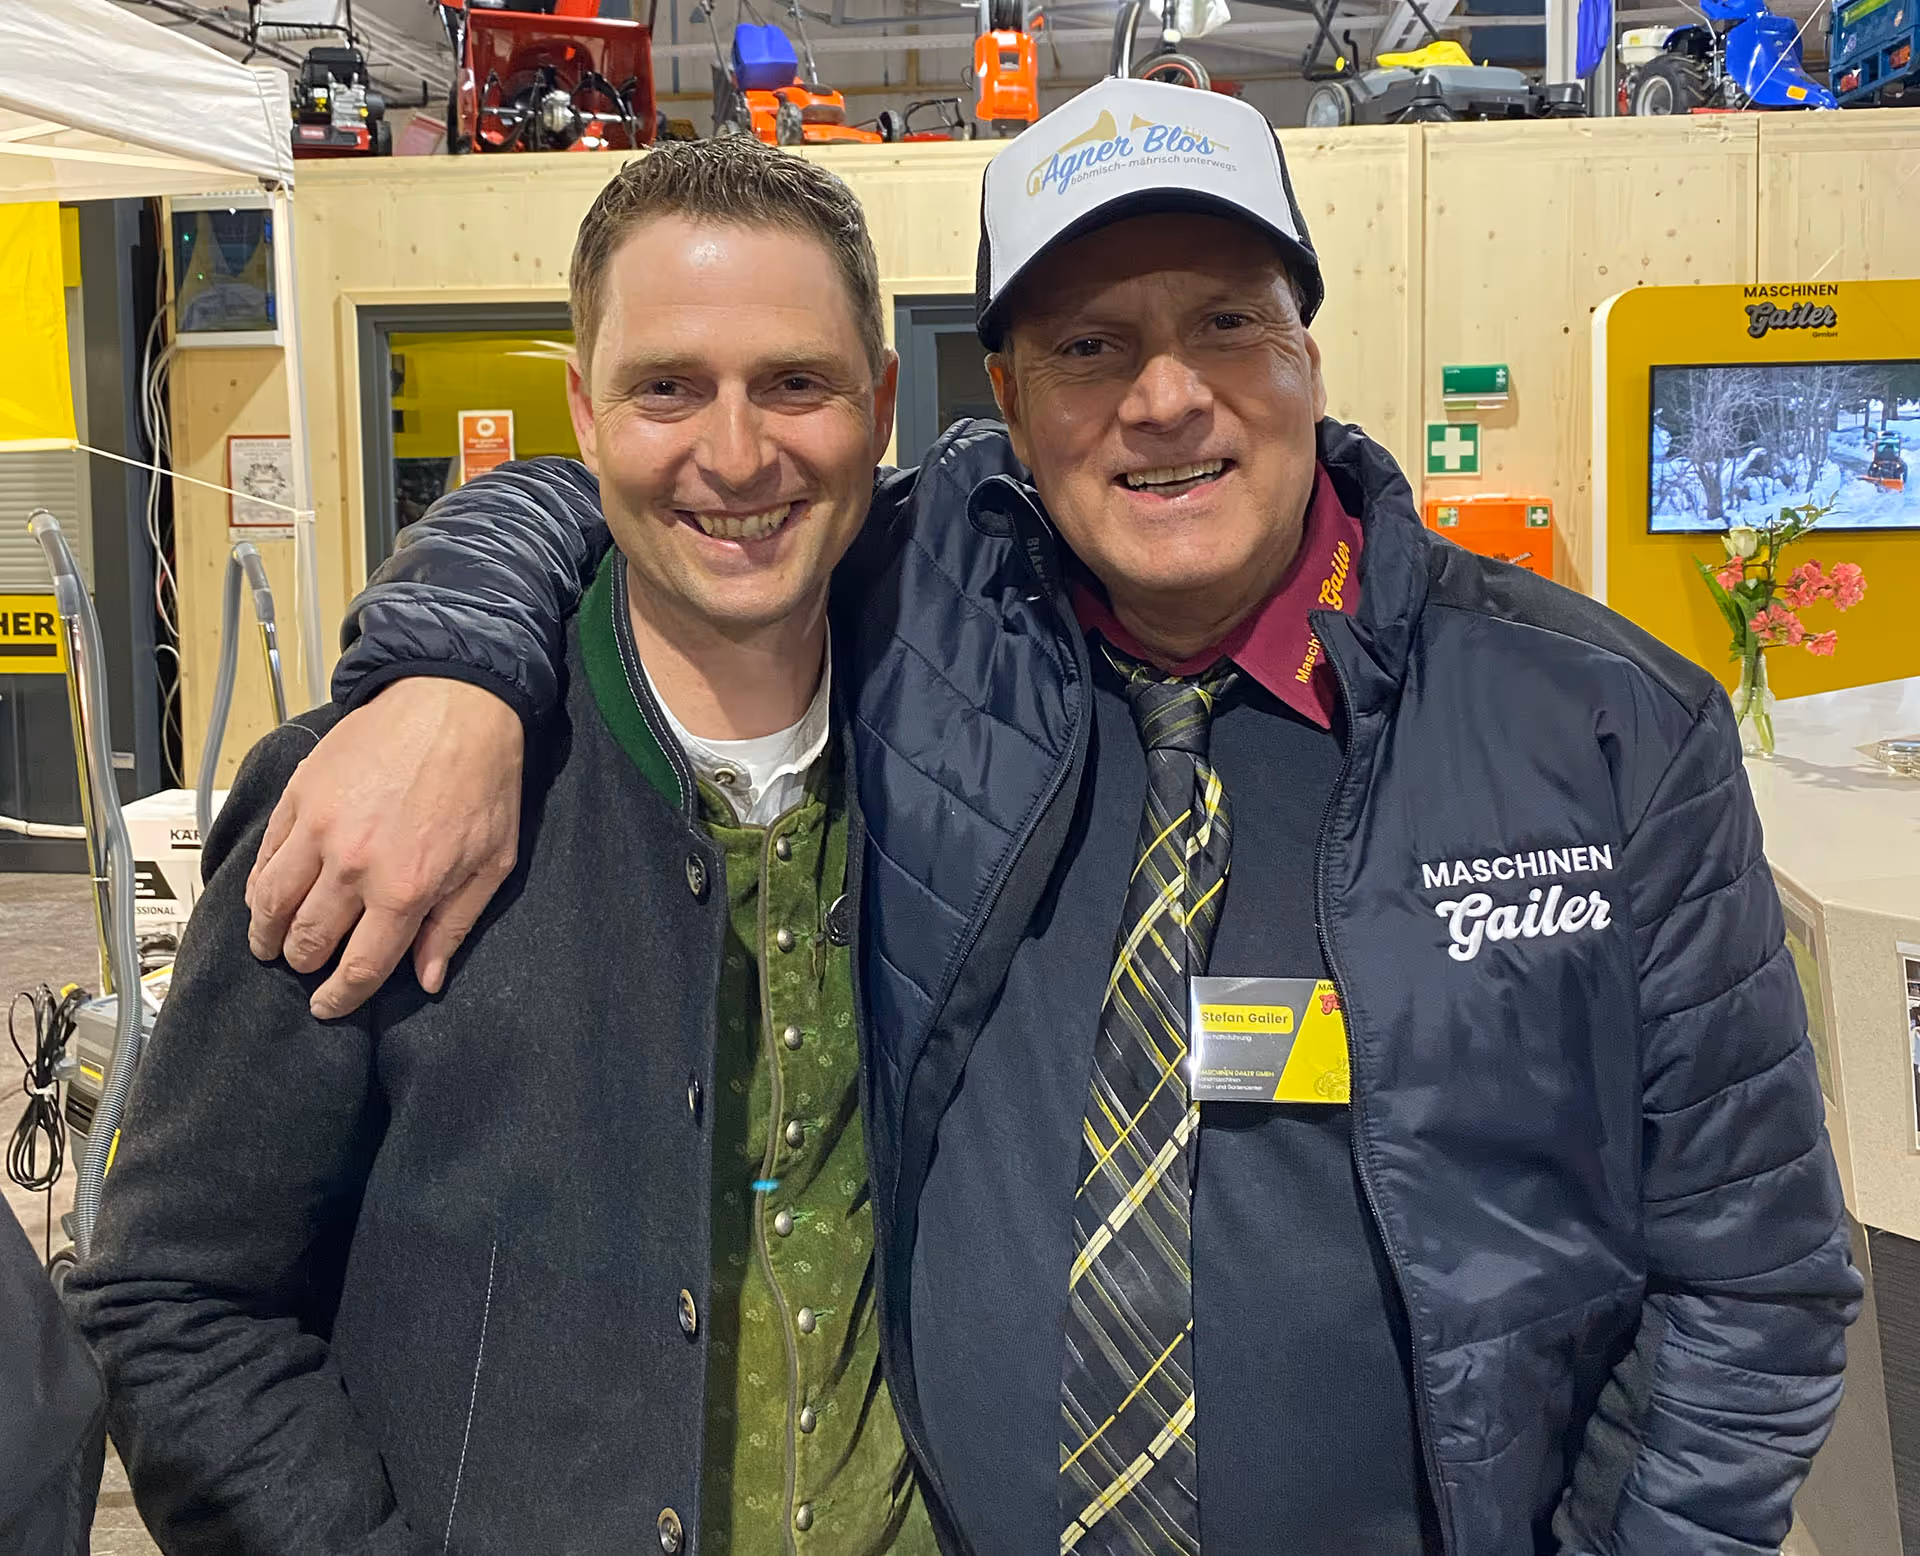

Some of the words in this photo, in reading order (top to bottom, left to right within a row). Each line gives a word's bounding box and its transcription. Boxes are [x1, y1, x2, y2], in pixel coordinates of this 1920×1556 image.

[1042, 135, 1133, 195] Agner
[1184, 156, 1238, 172] unterwegs
[1744, 284, 1838, 297] MASCHINEN
[1745, 301, 1838, 338] Gailer
[1318, 540, 1351, 611] Gailer
[1295, 632, 1321, 684] Masch
[1421, 843, 1614, 889] MASCHINEN
[1435, 884, 1612, 962] Gailer
[1201, 1012, 1244, 1023] Stefan
[1249, 1013, 1288, 1024] Gailer
